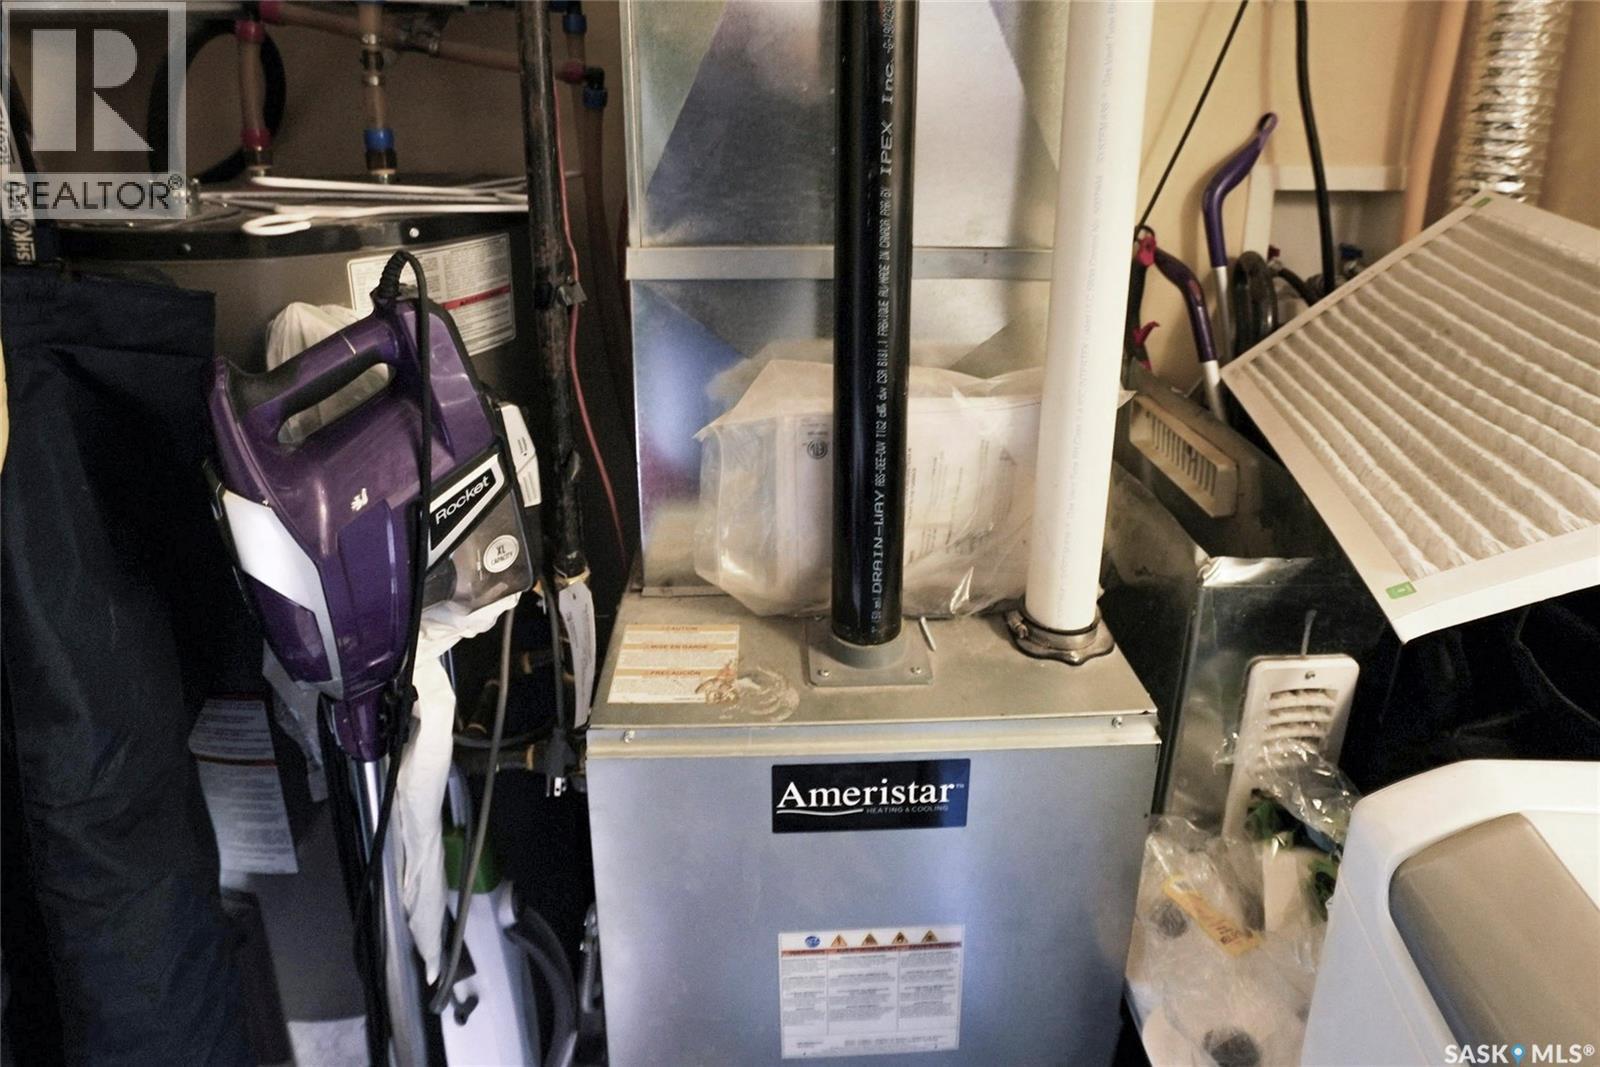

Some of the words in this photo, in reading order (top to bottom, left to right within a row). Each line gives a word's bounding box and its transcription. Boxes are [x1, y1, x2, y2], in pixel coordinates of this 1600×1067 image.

[882, 58, 895, 105] Inc.
[880, 120, 893, 176] IPEX
[879, 219, 891, 249] CANADA
[435, 476, 490, 525] Rocket
[496, 544, 506, 556] XL
[872, 490, 885, 594] DRAIN-WAY
[776, 778, 955, 808] Ameristar
[866, 807, 904, 815] HEATING
[911, 804, 949, 813] COOLING
